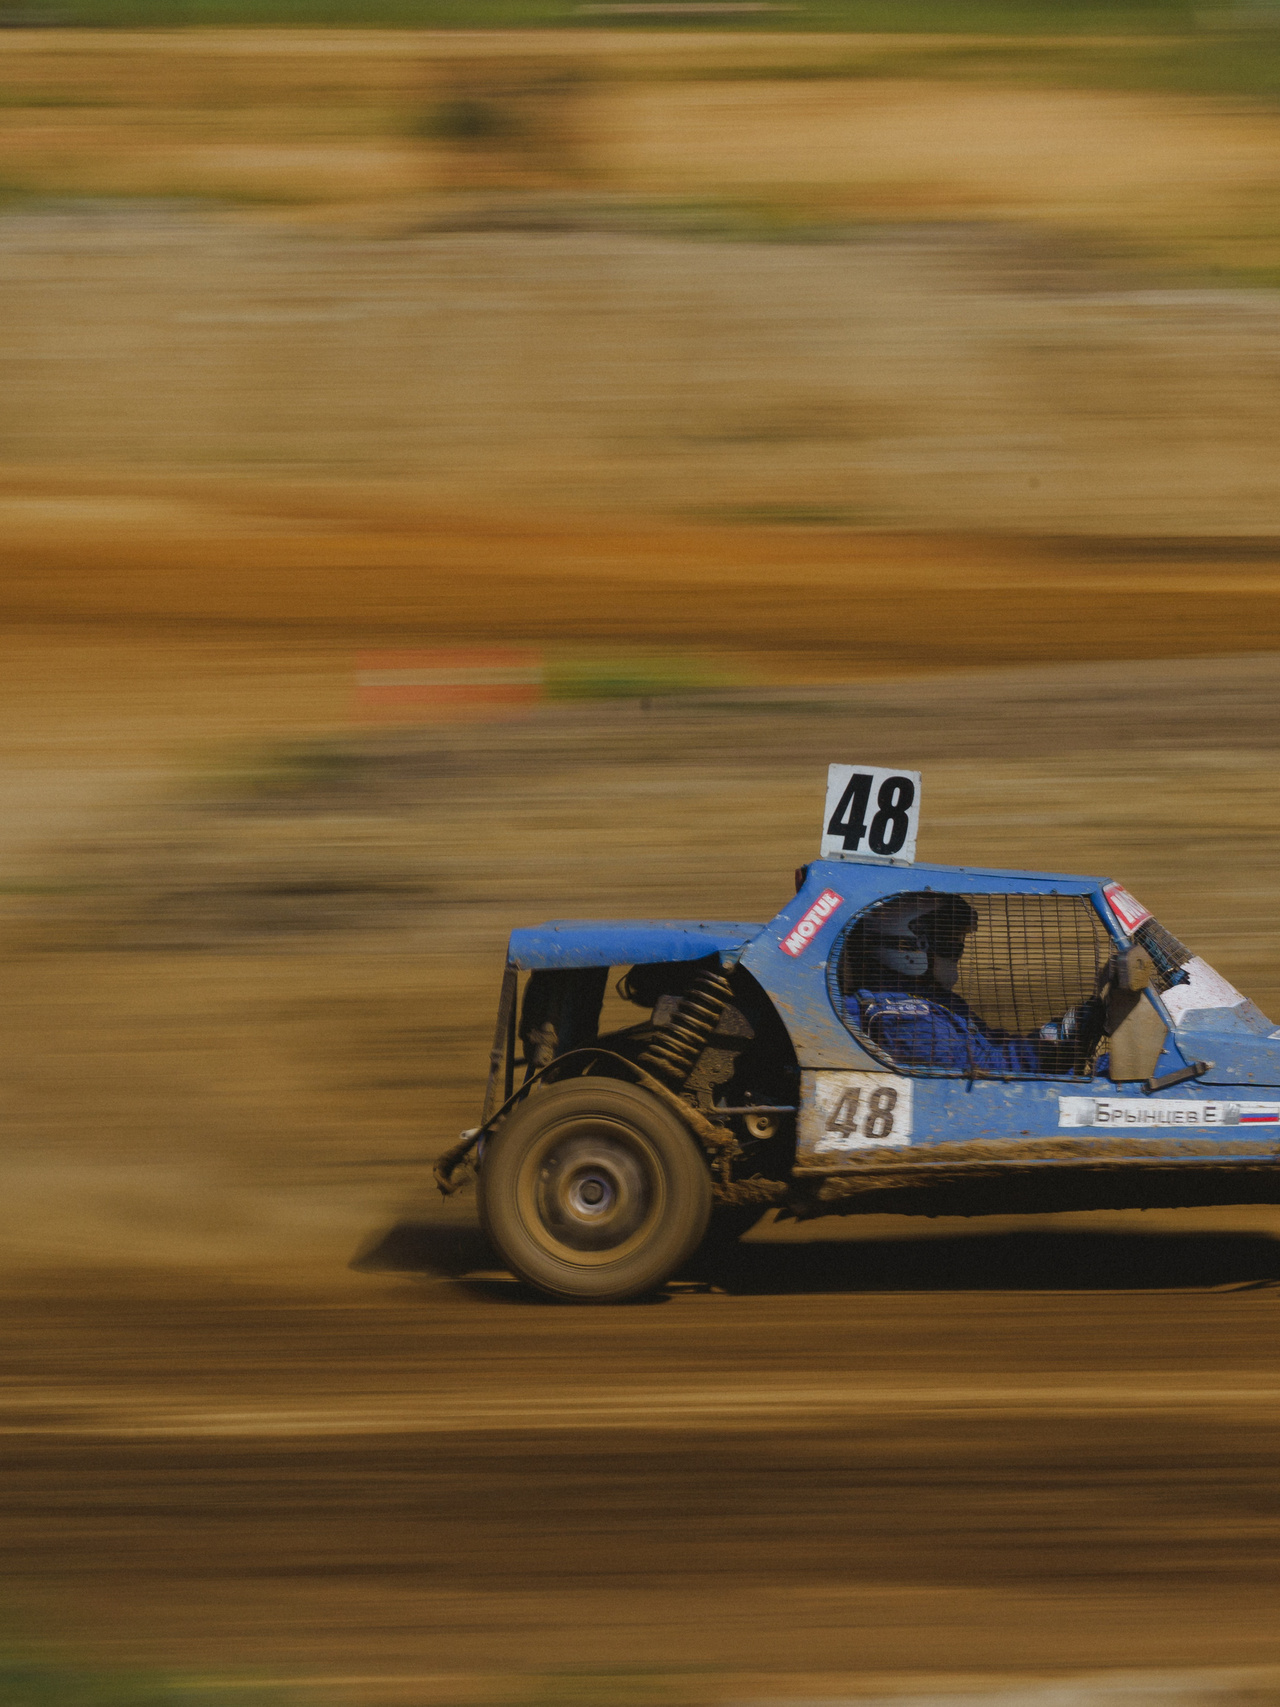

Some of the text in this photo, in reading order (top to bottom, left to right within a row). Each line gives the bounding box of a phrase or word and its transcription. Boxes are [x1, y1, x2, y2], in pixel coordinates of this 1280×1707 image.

[827, 773, 915, 855] 48
[785, 893, 840, 955] MOTUL
[825, 1087, 897, 1138] 48
